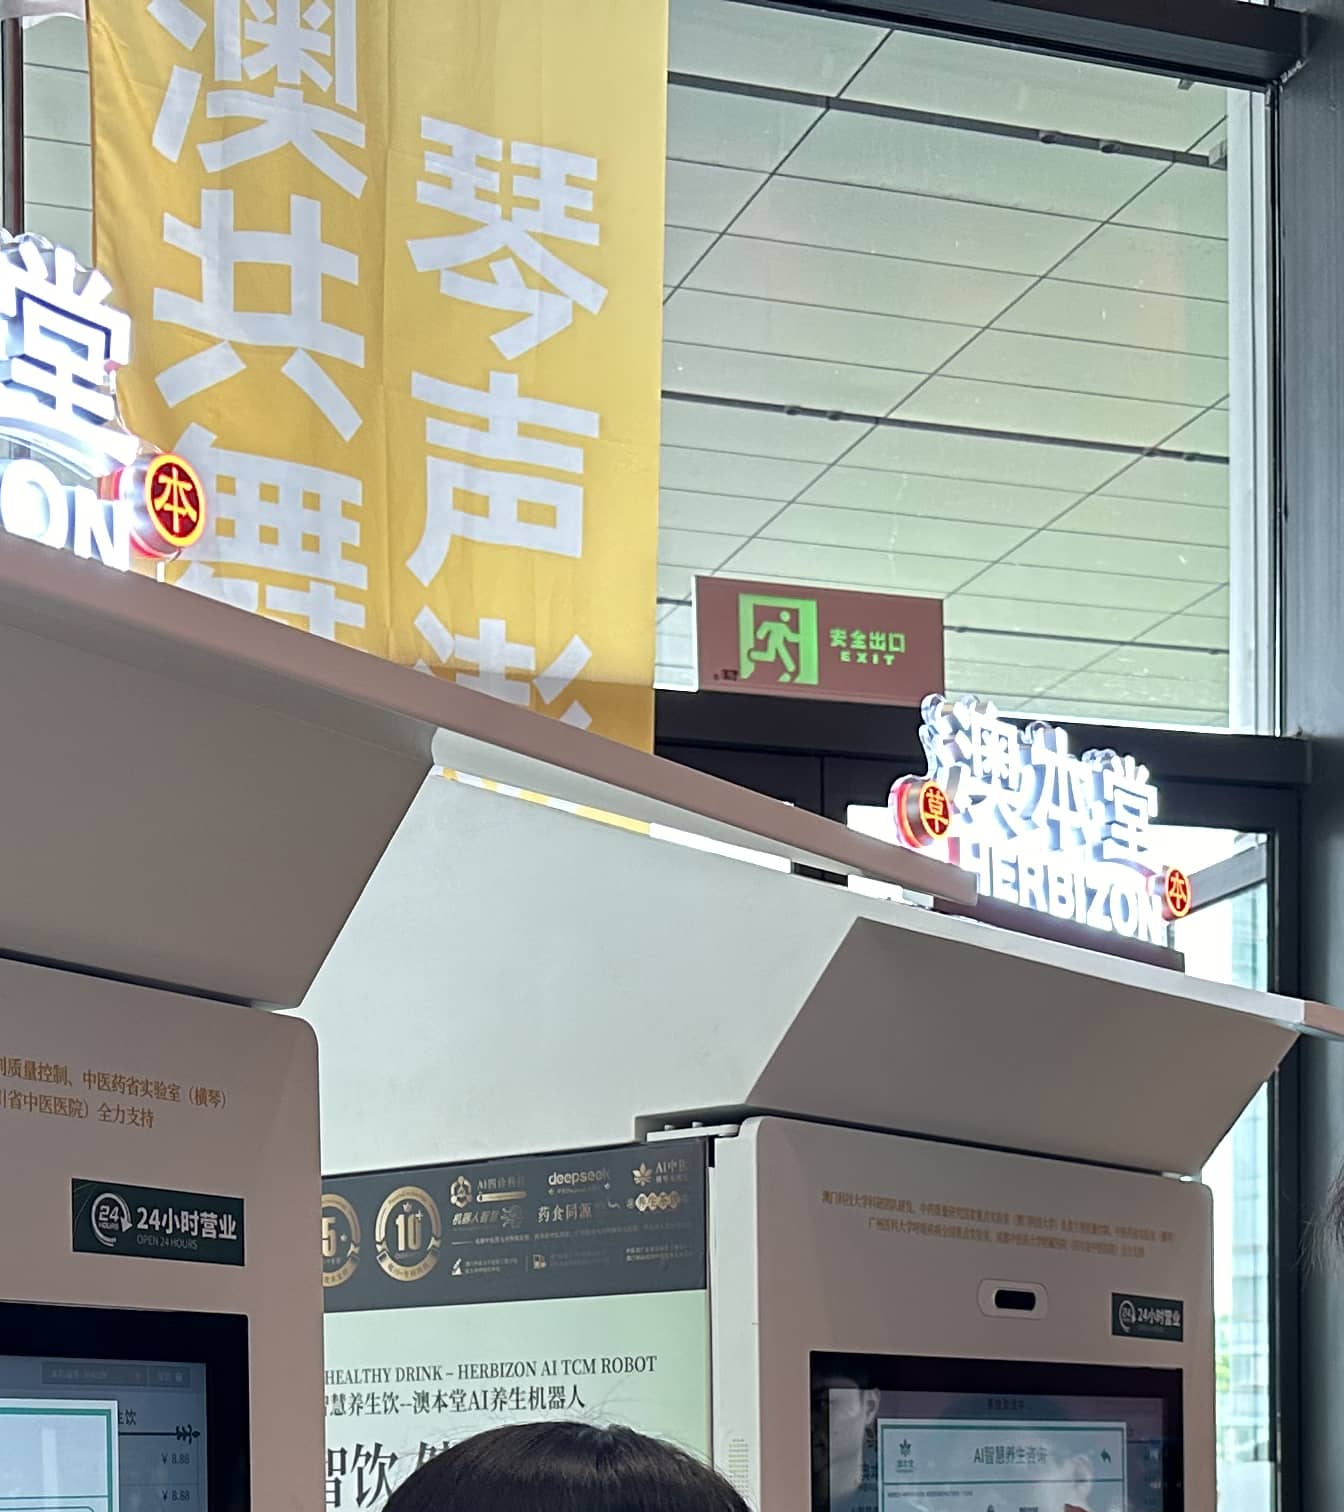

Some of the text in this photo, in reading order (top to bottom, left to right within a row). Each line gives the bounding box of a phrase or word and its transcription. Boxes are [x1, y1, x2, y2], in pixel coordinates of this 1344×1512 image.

[156, 467, 199, 532] 本
[829, 628, 906, 655] 安全出口
[840, 651, 896, 667] EXIT
[946, 702, 1158, 864] 澳本堂
[924, 788, 949, 838] 草
[960, 840, 1159, 946] HERBIZON
[1167, 875, 1188, 913] 本
[548, 1168, 610, 1187] deepseek
[98, 1204, 120, 1222] 24
[136, 1207, 238, 1241] 24小时营业
[537, 1203, 593, 1224] 药食同源
[136, 1234, 198, 1250] OPEN 24 HOURS
[1136, 1306, 1181, 1327] 24小时营业
[326, 1355, 657, 1386] HEALTHY DRINK HERBIZON AI TCM ROBOT
